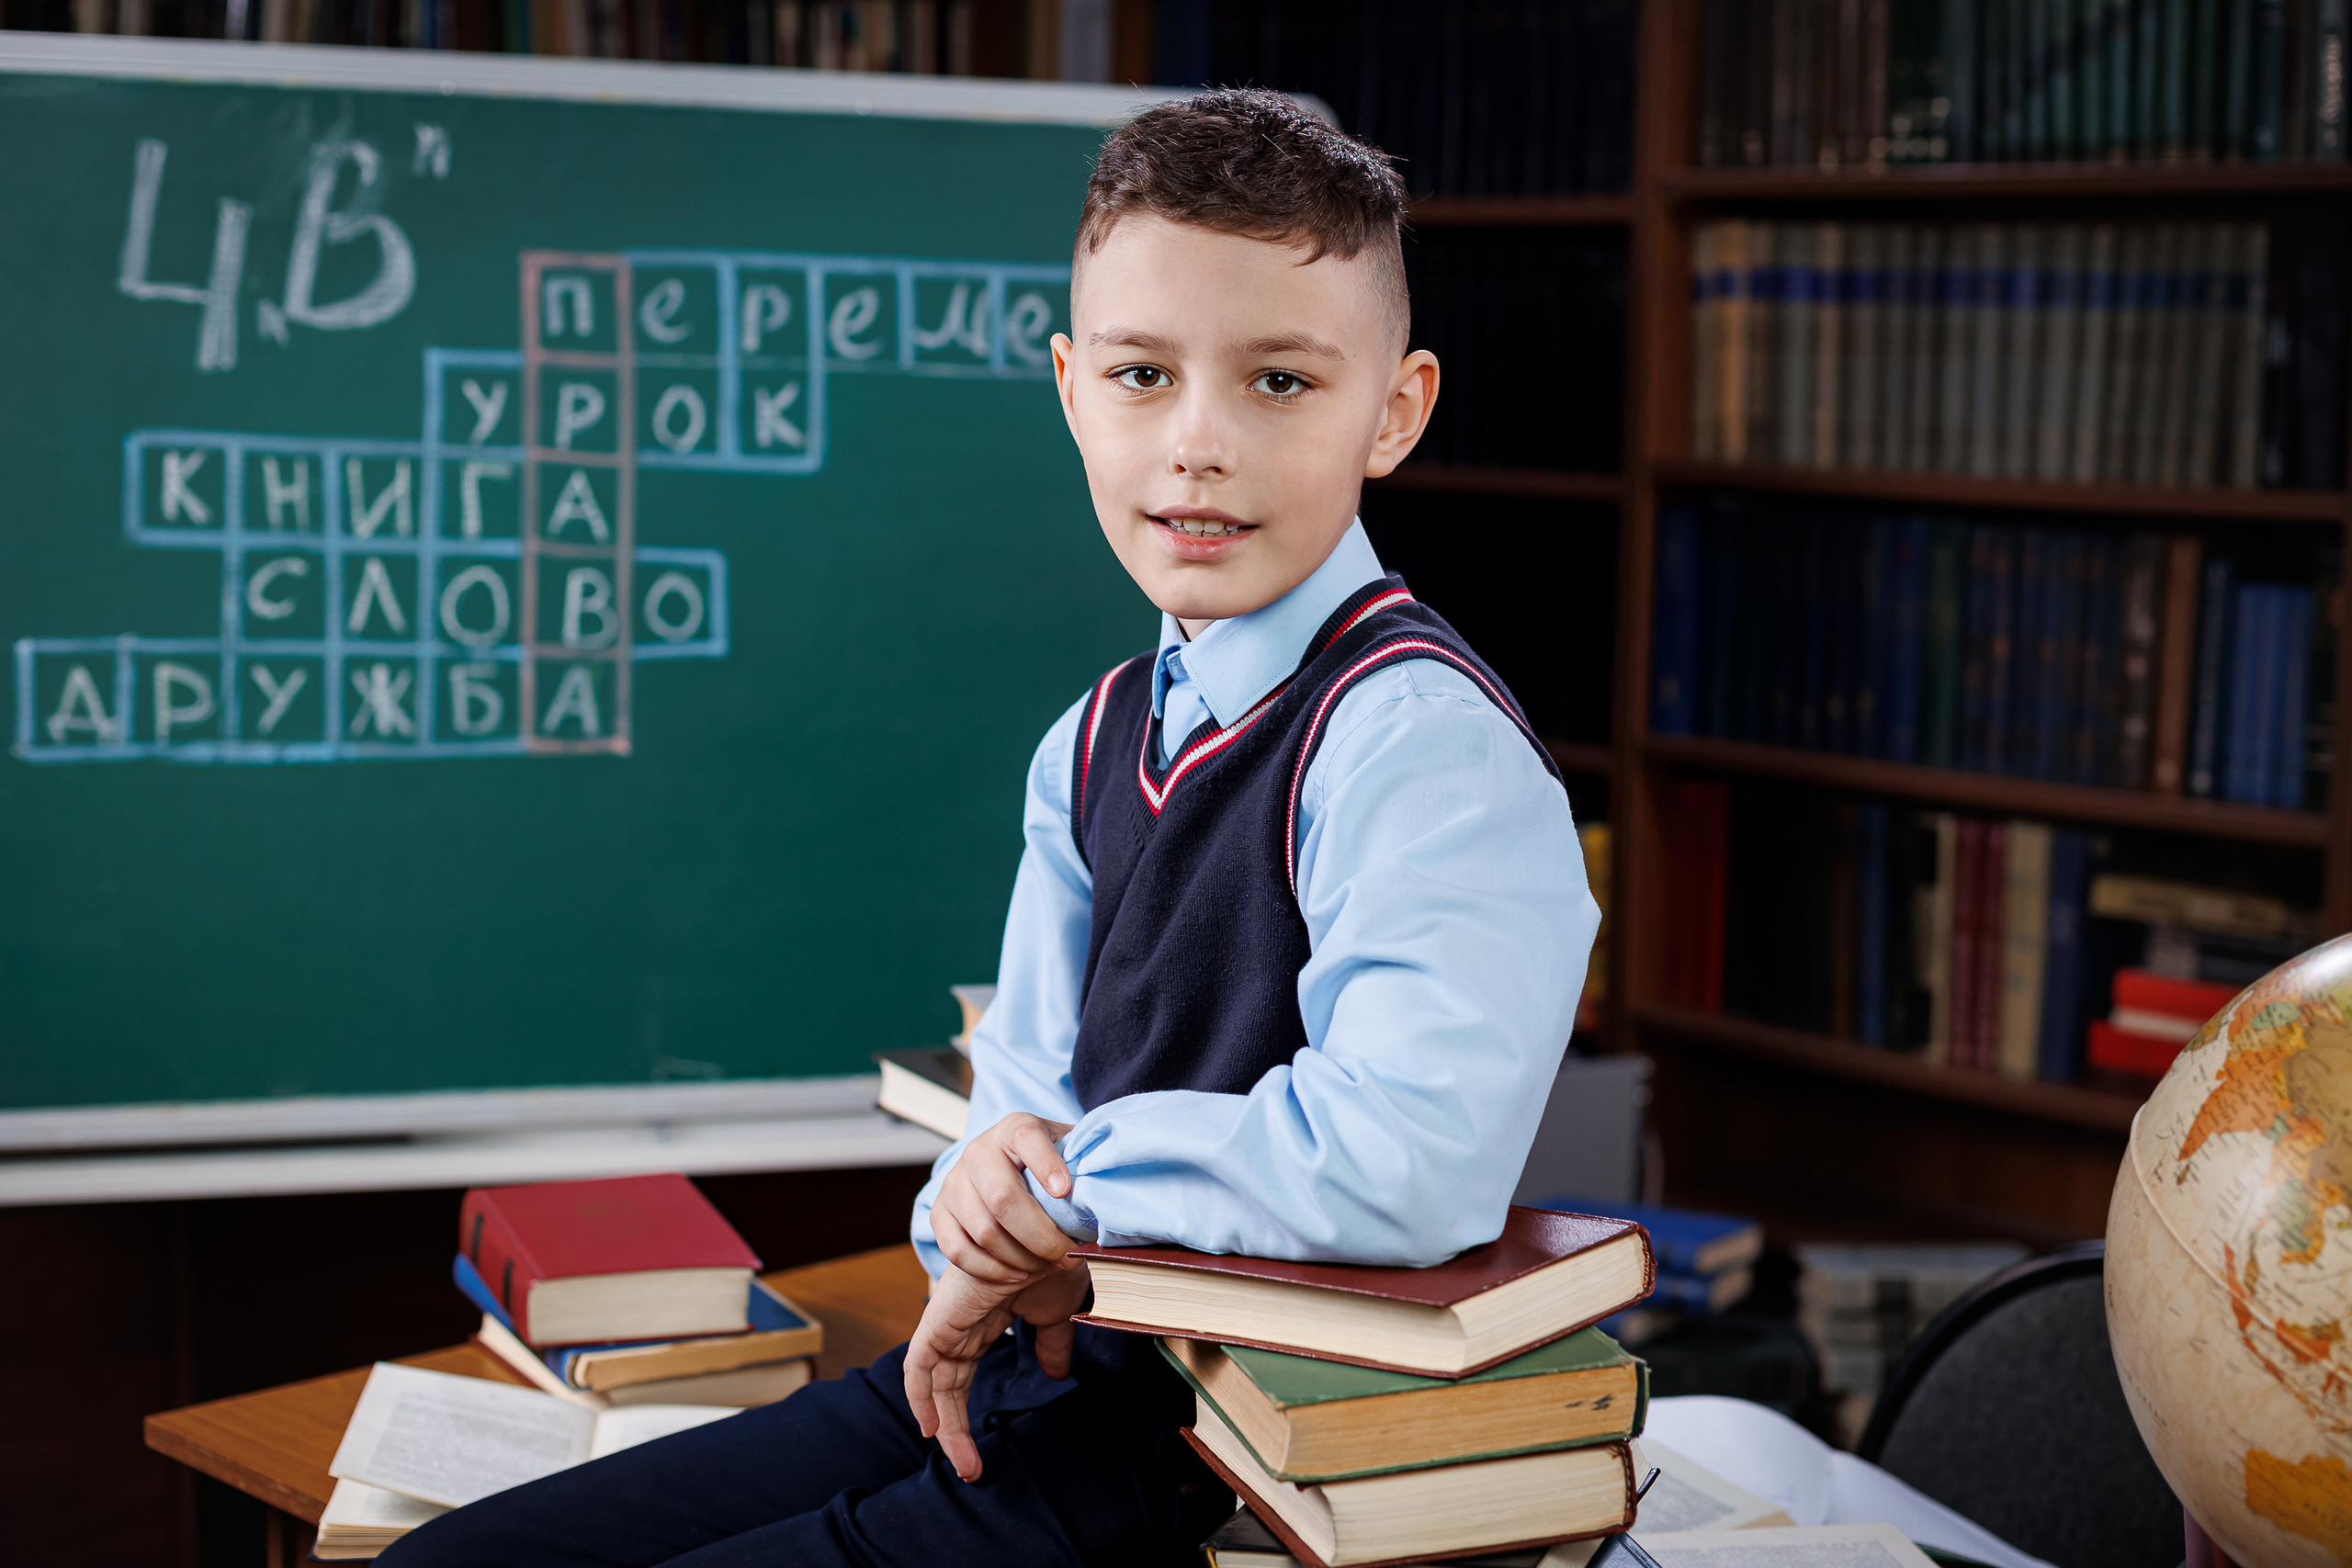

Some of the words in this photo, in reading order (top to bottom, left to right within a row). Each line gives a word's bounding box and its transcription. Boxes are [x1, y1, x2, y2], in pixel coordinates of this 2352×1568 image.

[161, 447, 609, 542] КНИГА
[246, 556, 705, 649] СЛОВО
[46, 662, 600, 744] ДРУЖБА
